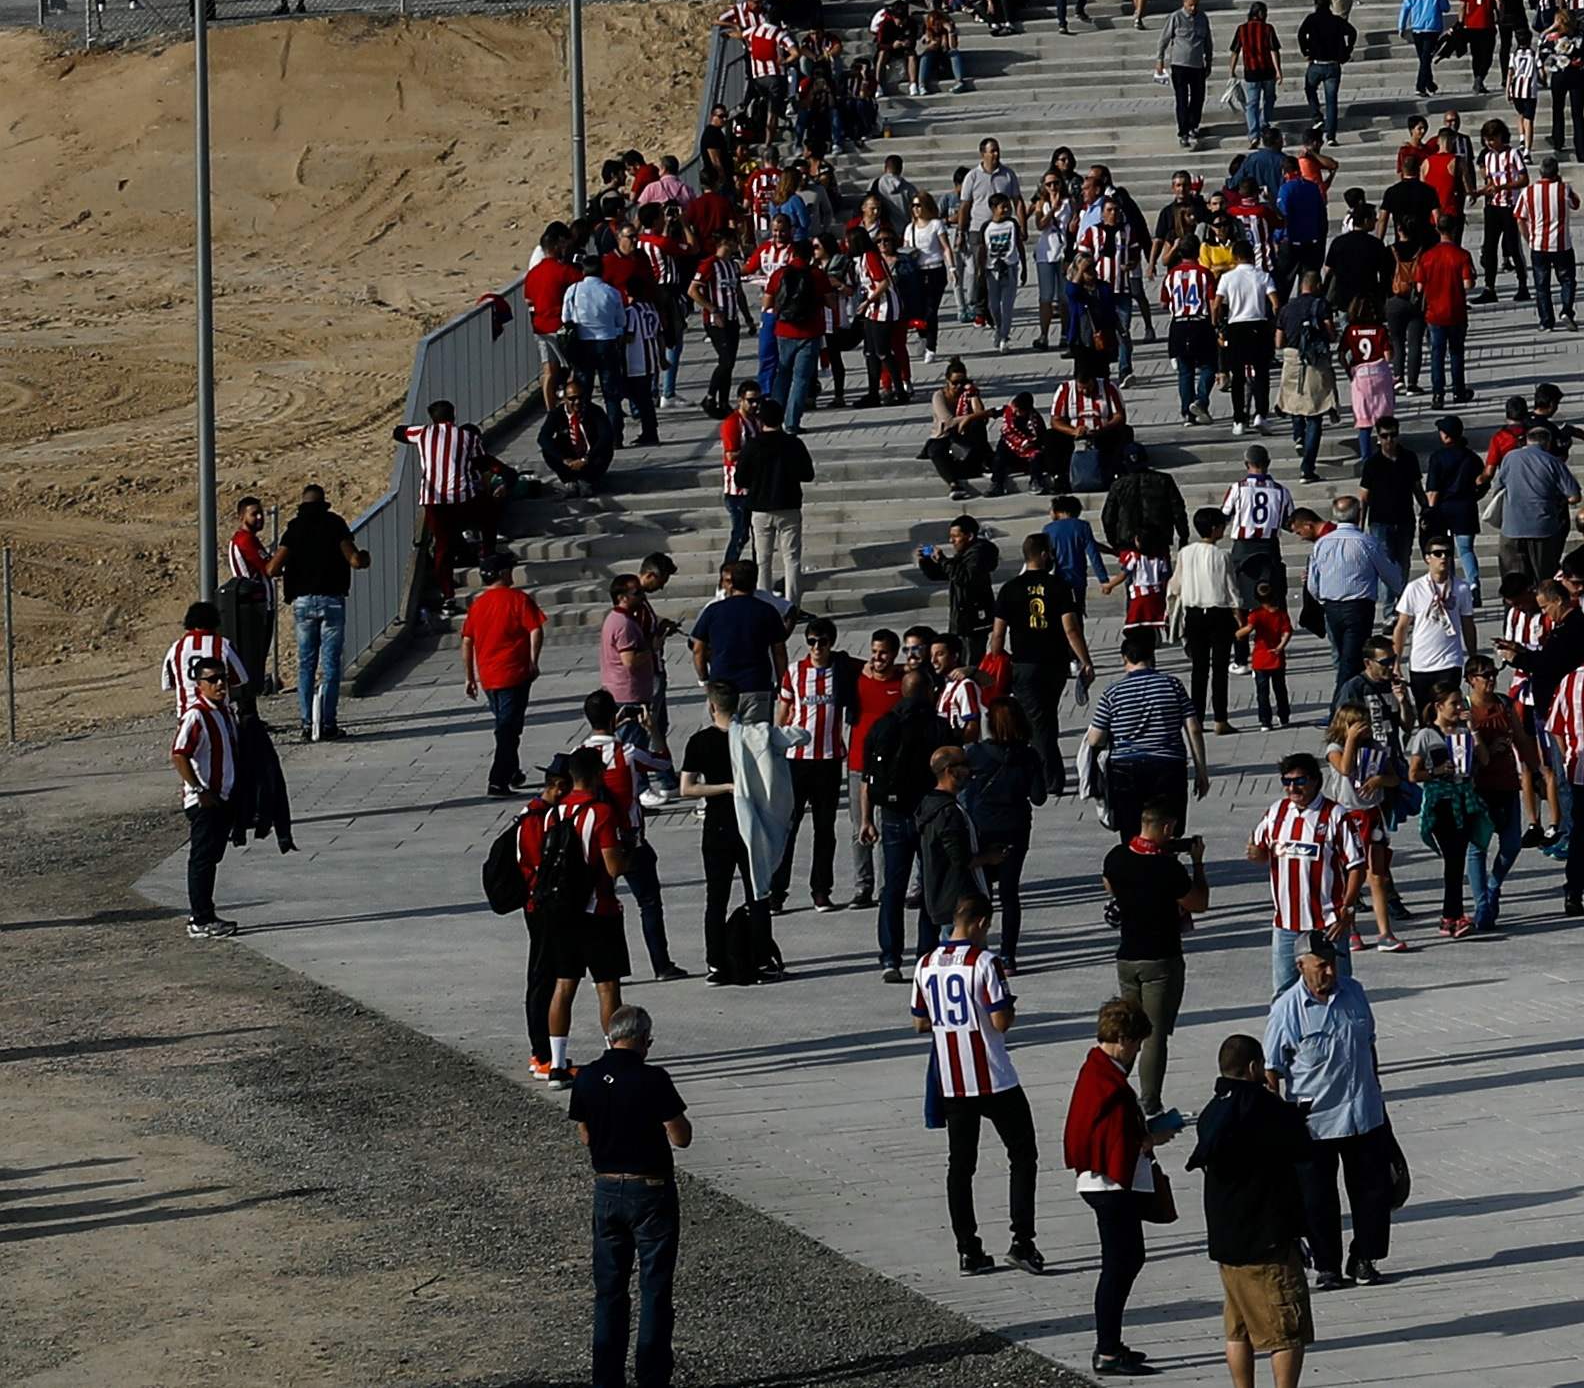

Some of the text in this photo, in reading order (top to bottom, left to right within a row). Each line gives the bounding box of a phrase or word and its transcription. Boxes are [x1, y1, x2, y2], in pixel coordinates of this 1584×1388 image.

[1173, 283, 1201, 310] 14
[1358, 337, 1372, 360] 9
[1253, 492, 1269, 524] 8
[925, 973, 968, 1026] 19
